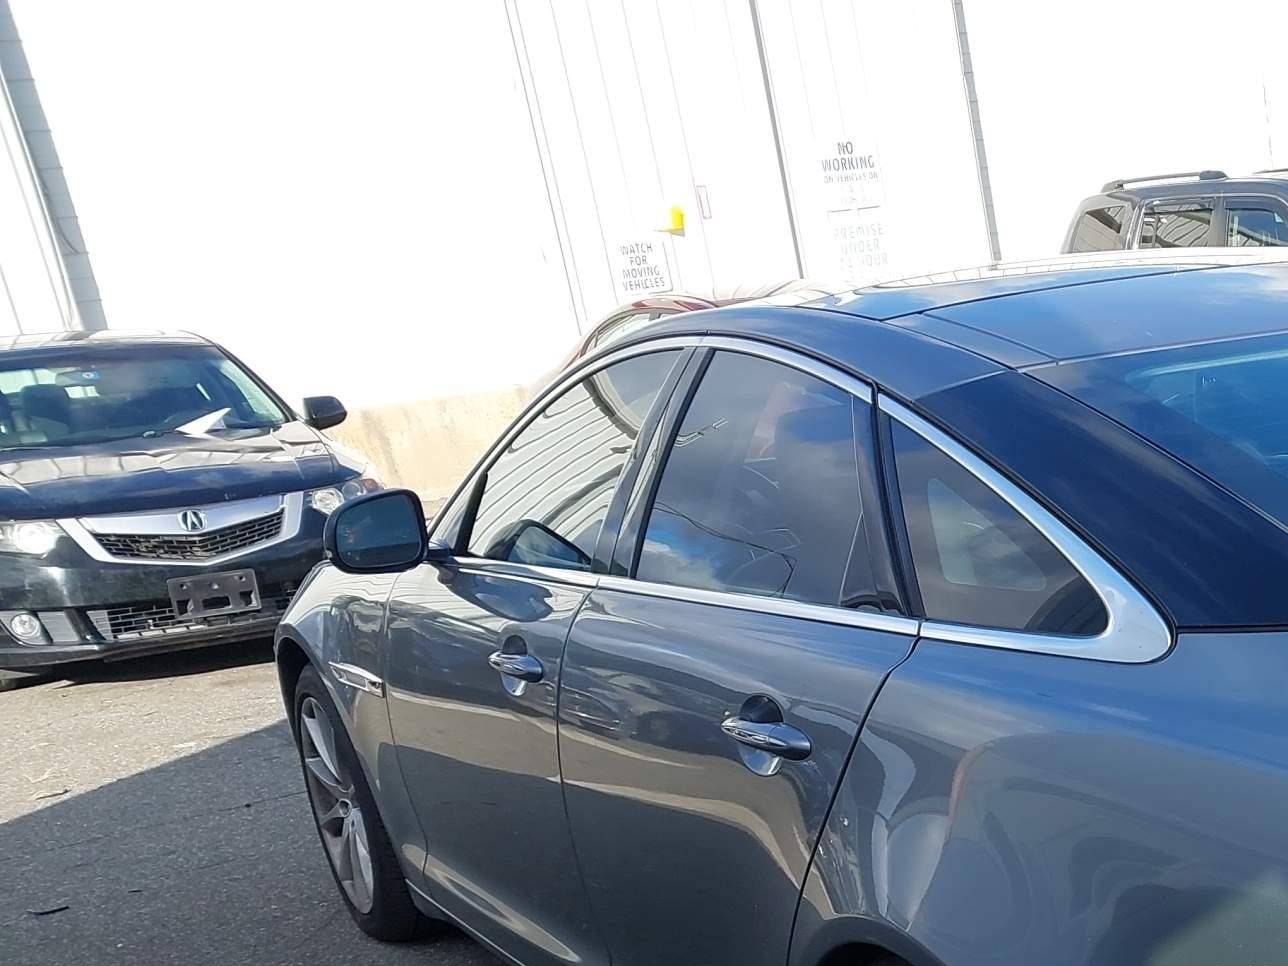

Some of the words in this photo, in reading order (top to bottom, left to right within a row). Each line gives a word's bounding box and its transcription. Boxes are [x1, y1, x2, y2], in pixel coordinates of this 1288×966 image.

[836, 140, 854, 155] NO
[821, 155, 875, 172] WORKING
[620, 242, 653, 255] WATCH
[629, 255, 648, 266] FOR
[622, 265, 660, 279] MOVING
[622, 277, 665, 291] VEHICLES
